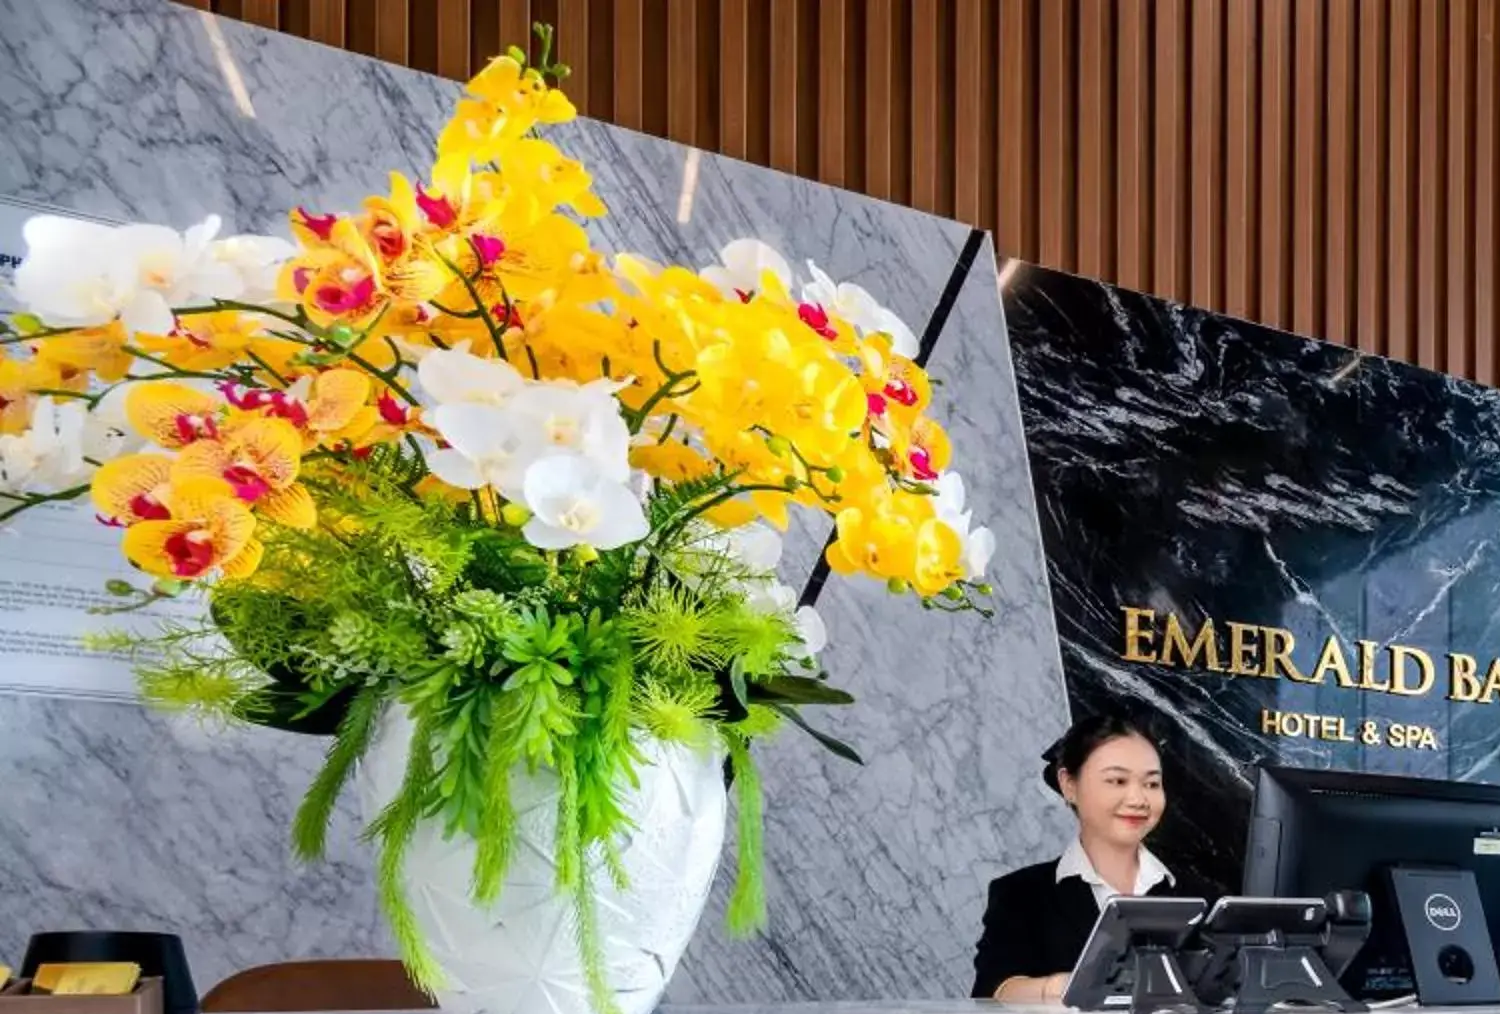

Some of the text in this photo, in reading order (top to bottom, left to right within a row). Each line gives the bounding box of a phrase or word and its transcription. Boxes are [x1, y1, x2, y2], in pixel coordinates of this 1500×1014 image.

[1119, 605, 1435, 697] EMERALD
[1261, 709, 1438, 750] HOTEL & SPA
[1429, 907, 1457, 917] DELL
